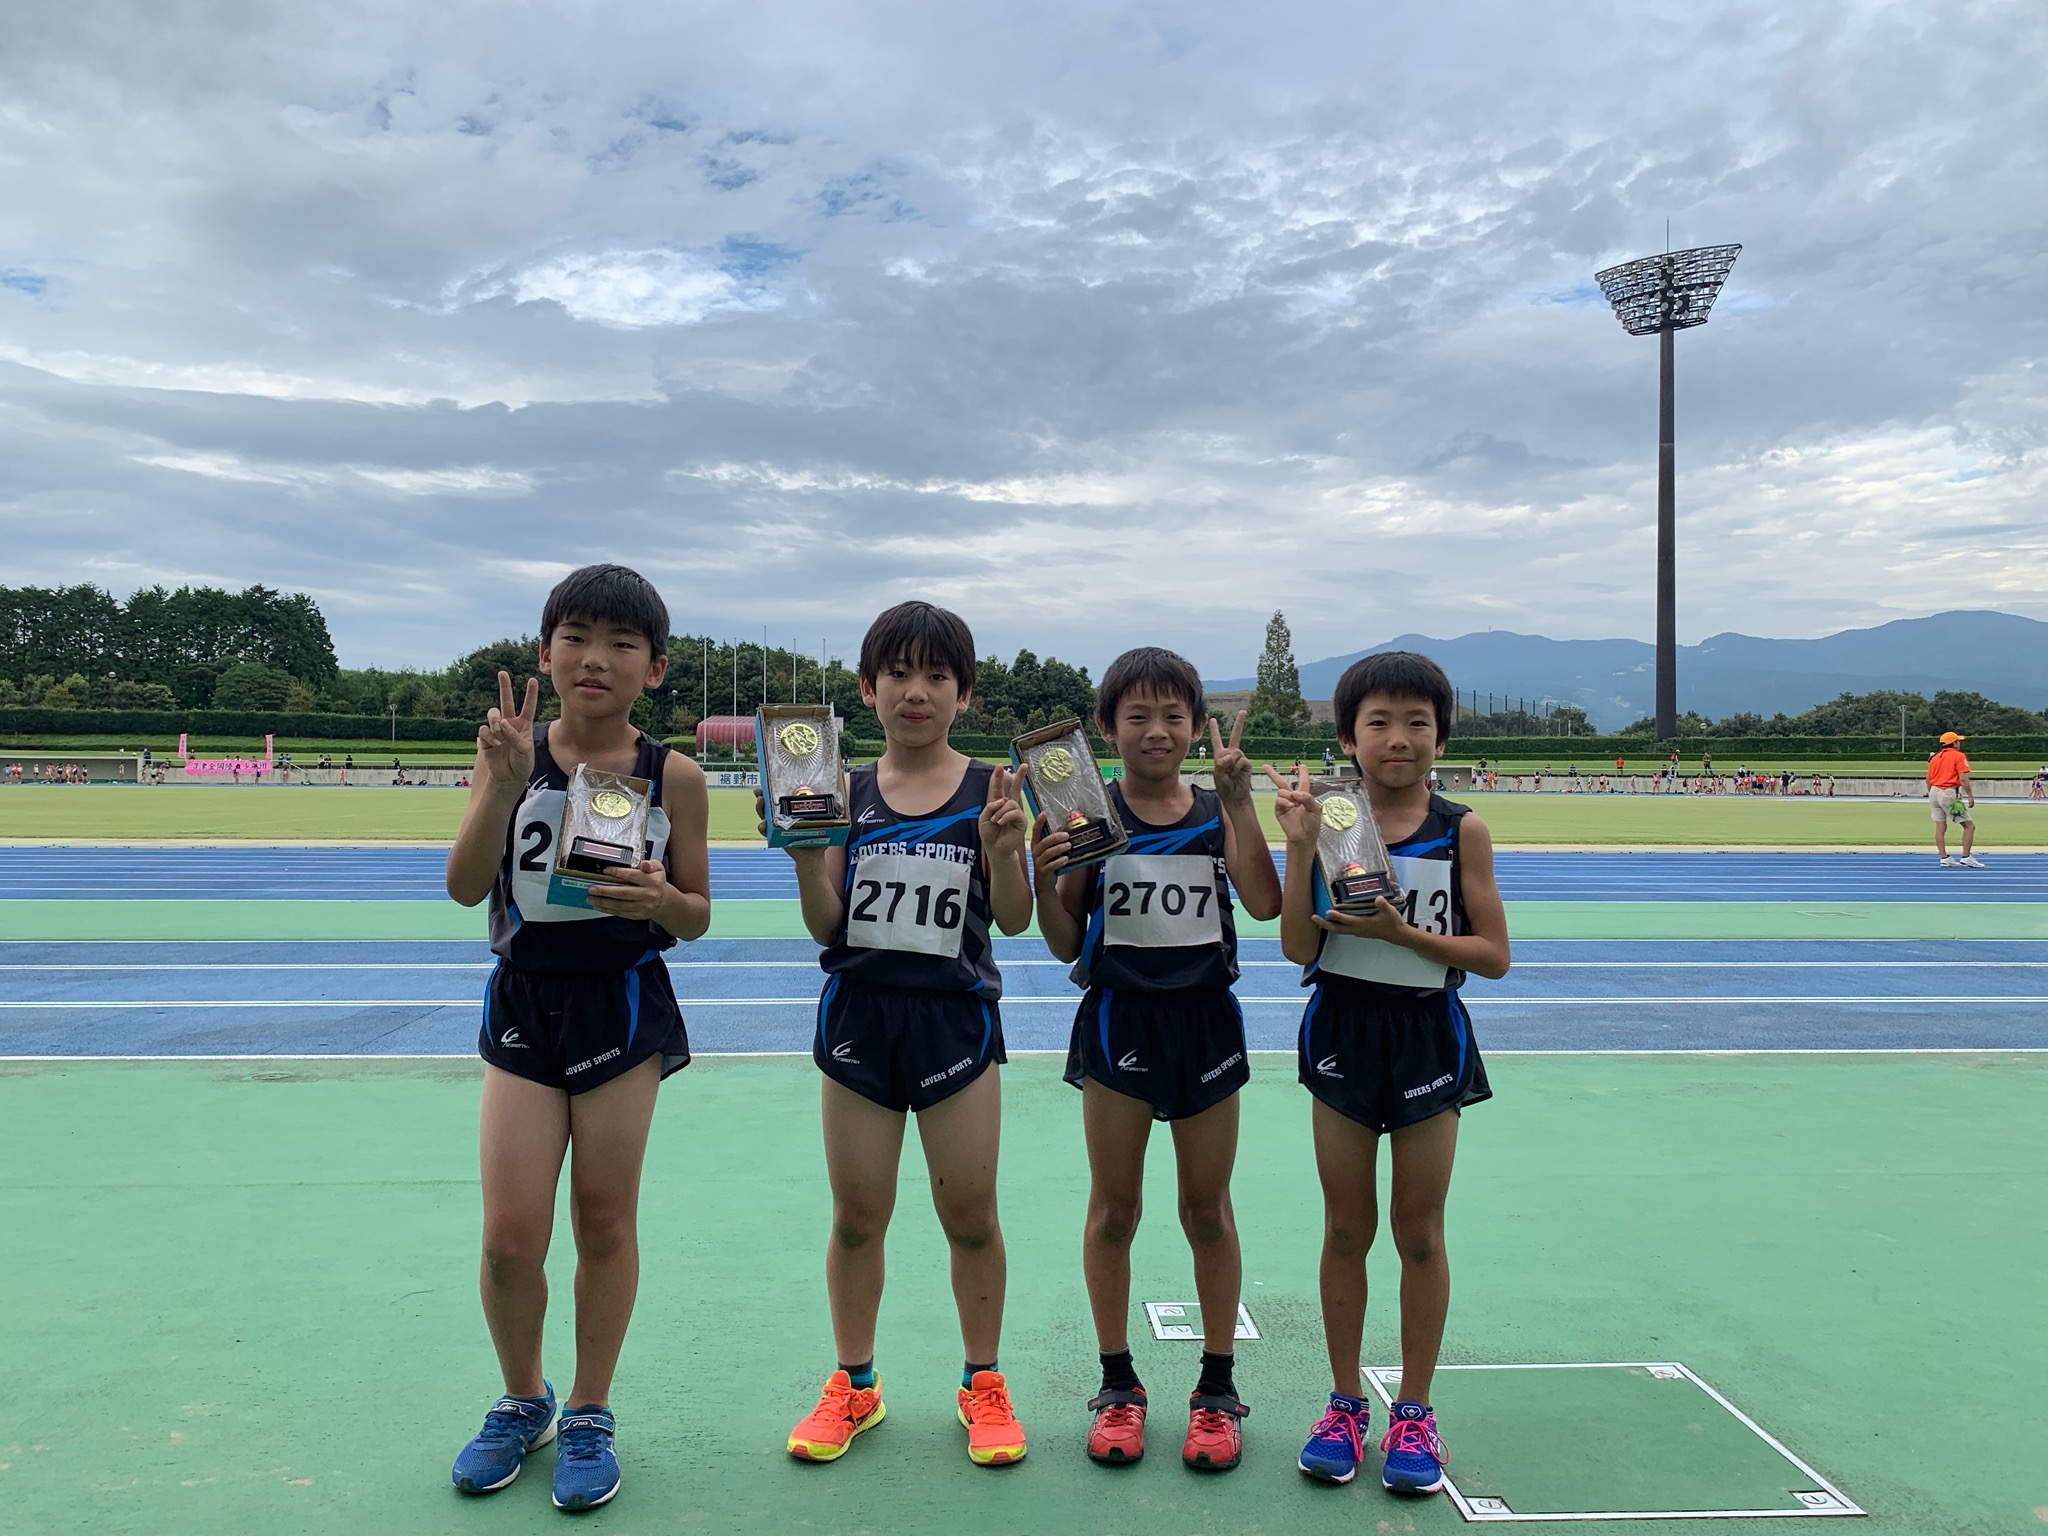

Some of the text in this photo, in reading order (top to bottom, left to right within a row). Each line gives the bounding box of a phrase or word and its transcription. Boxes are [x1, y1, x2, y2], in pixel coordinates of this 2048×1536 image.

[850, 841, 976, 866] LOVERS SPORTS
[852, 879, 962, 930] 2716
[1108, 882, 1213, 918] 2707
[565, 1047, 621, 1076] LOVERS SPORTS
[920, 1057, 973, 1088] LOVERS SPORTS
[1200, 1052, 1243, 1083] LOVERS SPORTS
[1404, 1085, 1431, 1099] LOVERS
